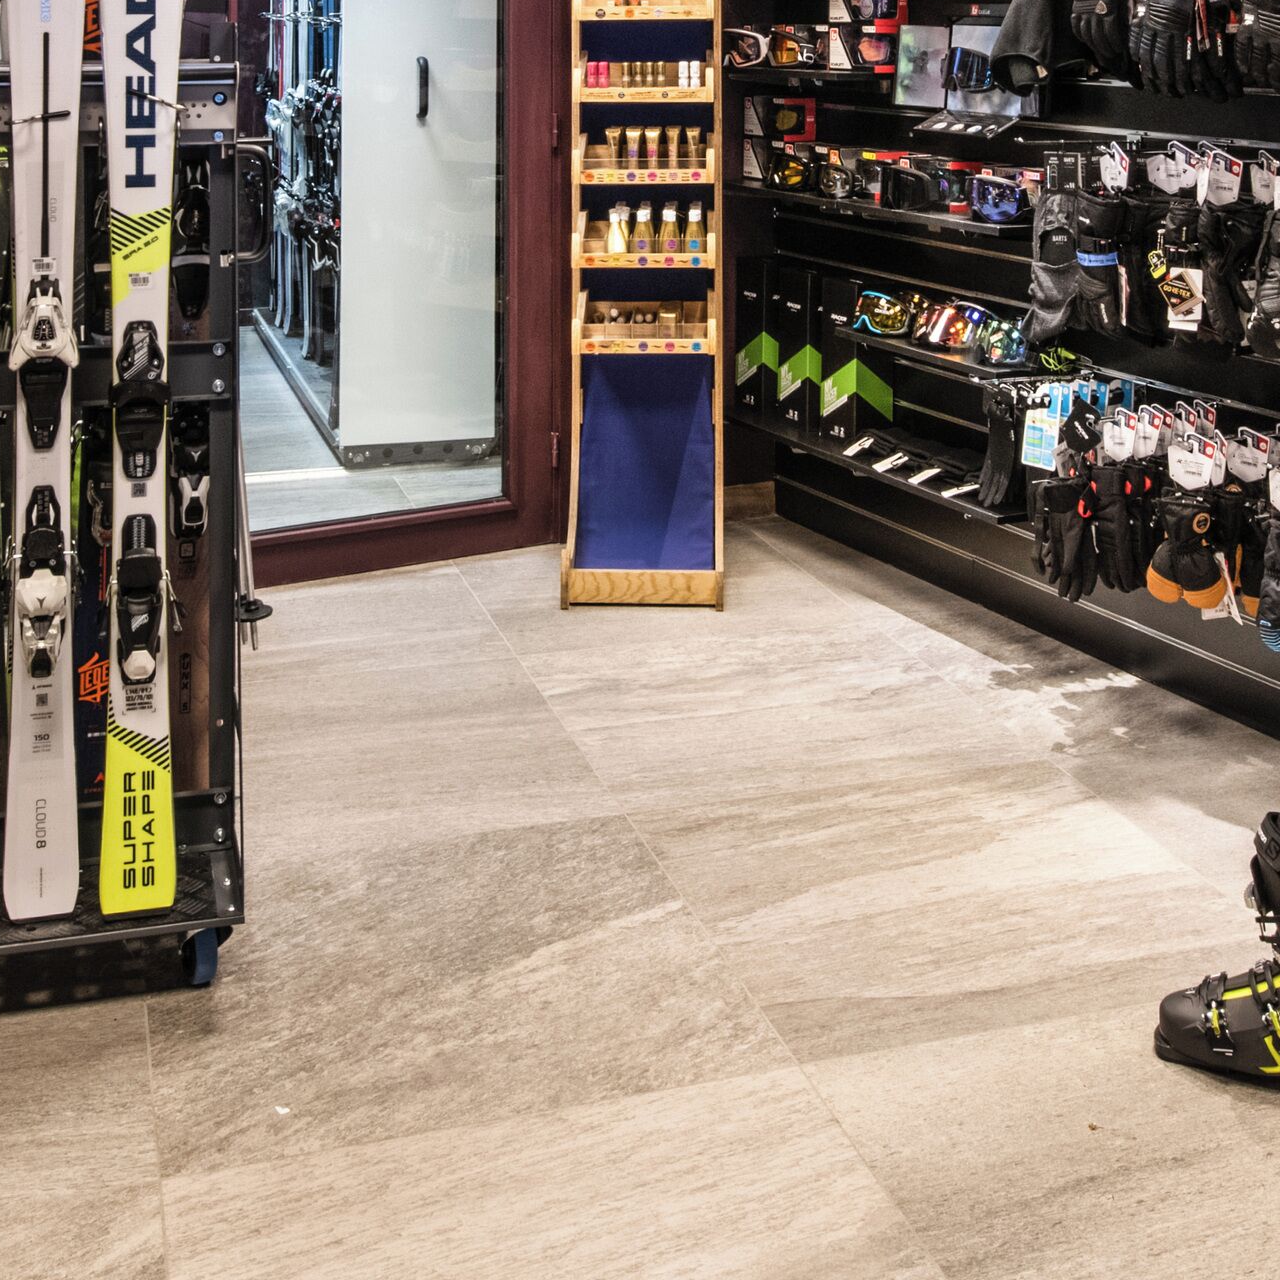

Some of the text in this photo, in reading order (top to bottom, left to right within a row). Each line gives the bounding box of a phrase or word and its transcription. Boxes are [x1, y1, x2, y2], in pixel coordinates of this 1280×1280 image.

[1051, 235, 1068, 243] BARTS
[1162, 283, 1191, 298] GORE-TEX
[830, 313, 847, 322] RACER
[33, 733, 51, 742] 150
[122, 771, 138, 890] SUPER
[141, 769, 156, 888] SHAPE
